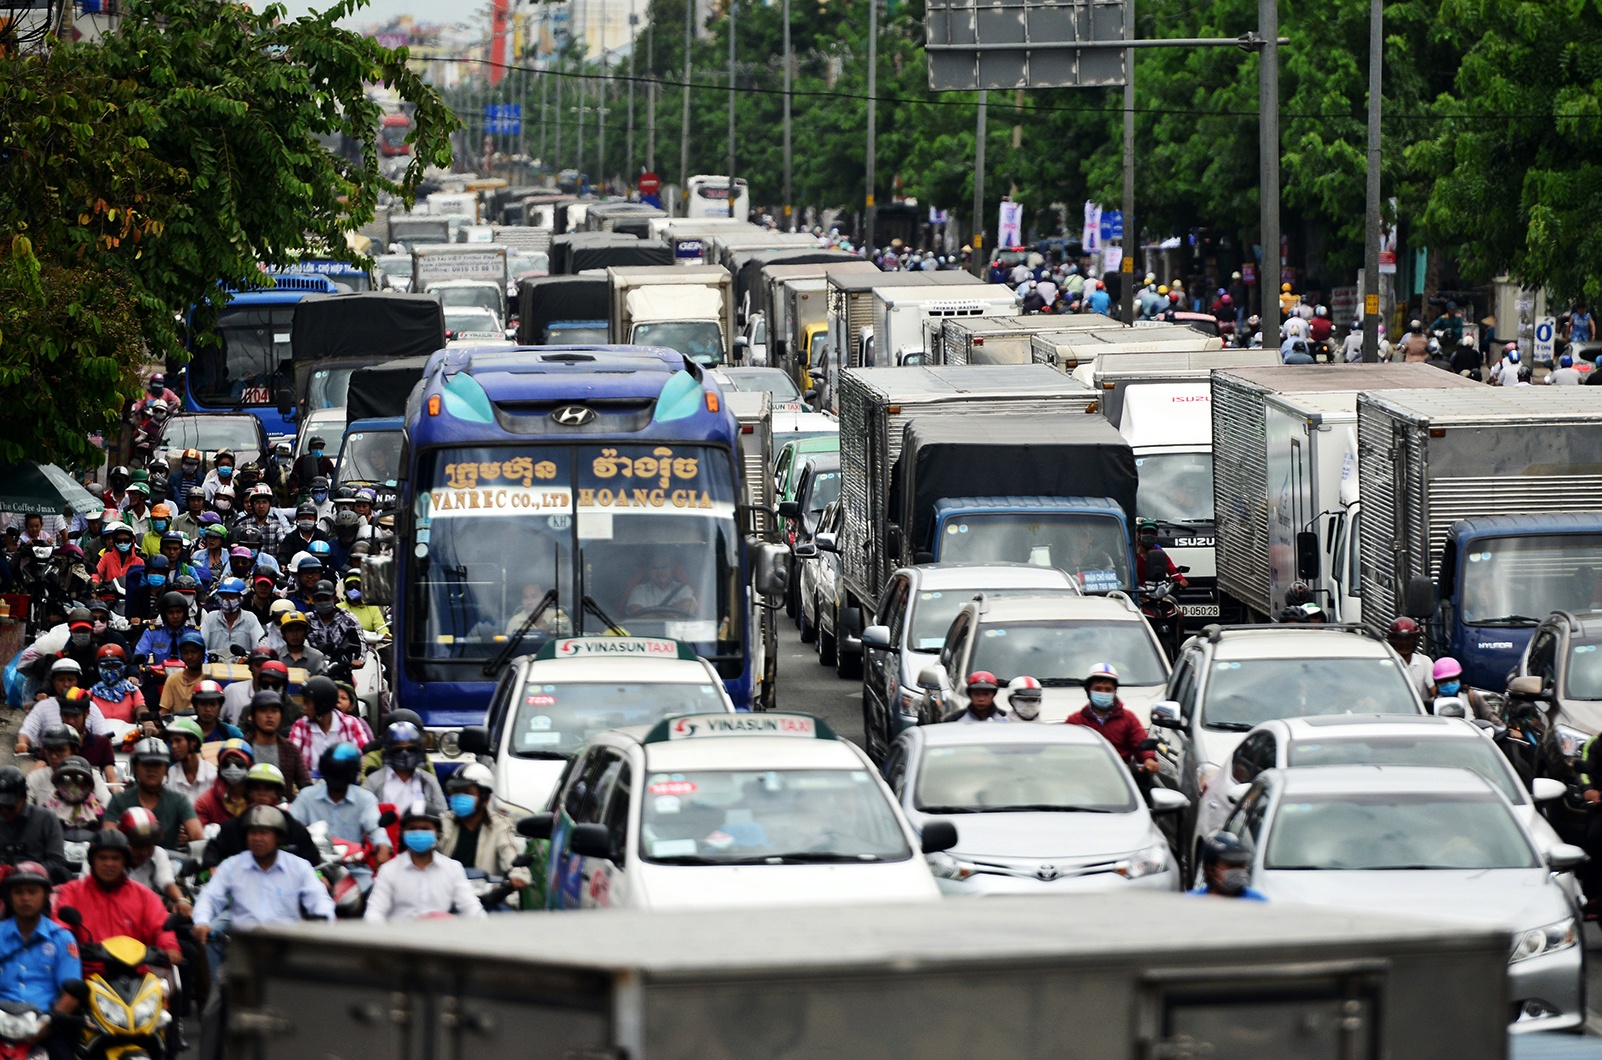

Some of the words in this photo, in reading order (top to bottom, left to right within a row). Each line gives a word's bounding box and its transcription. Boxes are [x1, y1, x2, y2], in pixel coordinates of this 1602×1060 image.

[578, 488, 665, 507] HOANG
[671, 489, 713, 509] GIA
[0, 501, 12, 510] The
[12, 502, 35, 511] Coffee
[553, 516, 567, 528] KH
[1174, 537, 1215, 547] ISUZU
